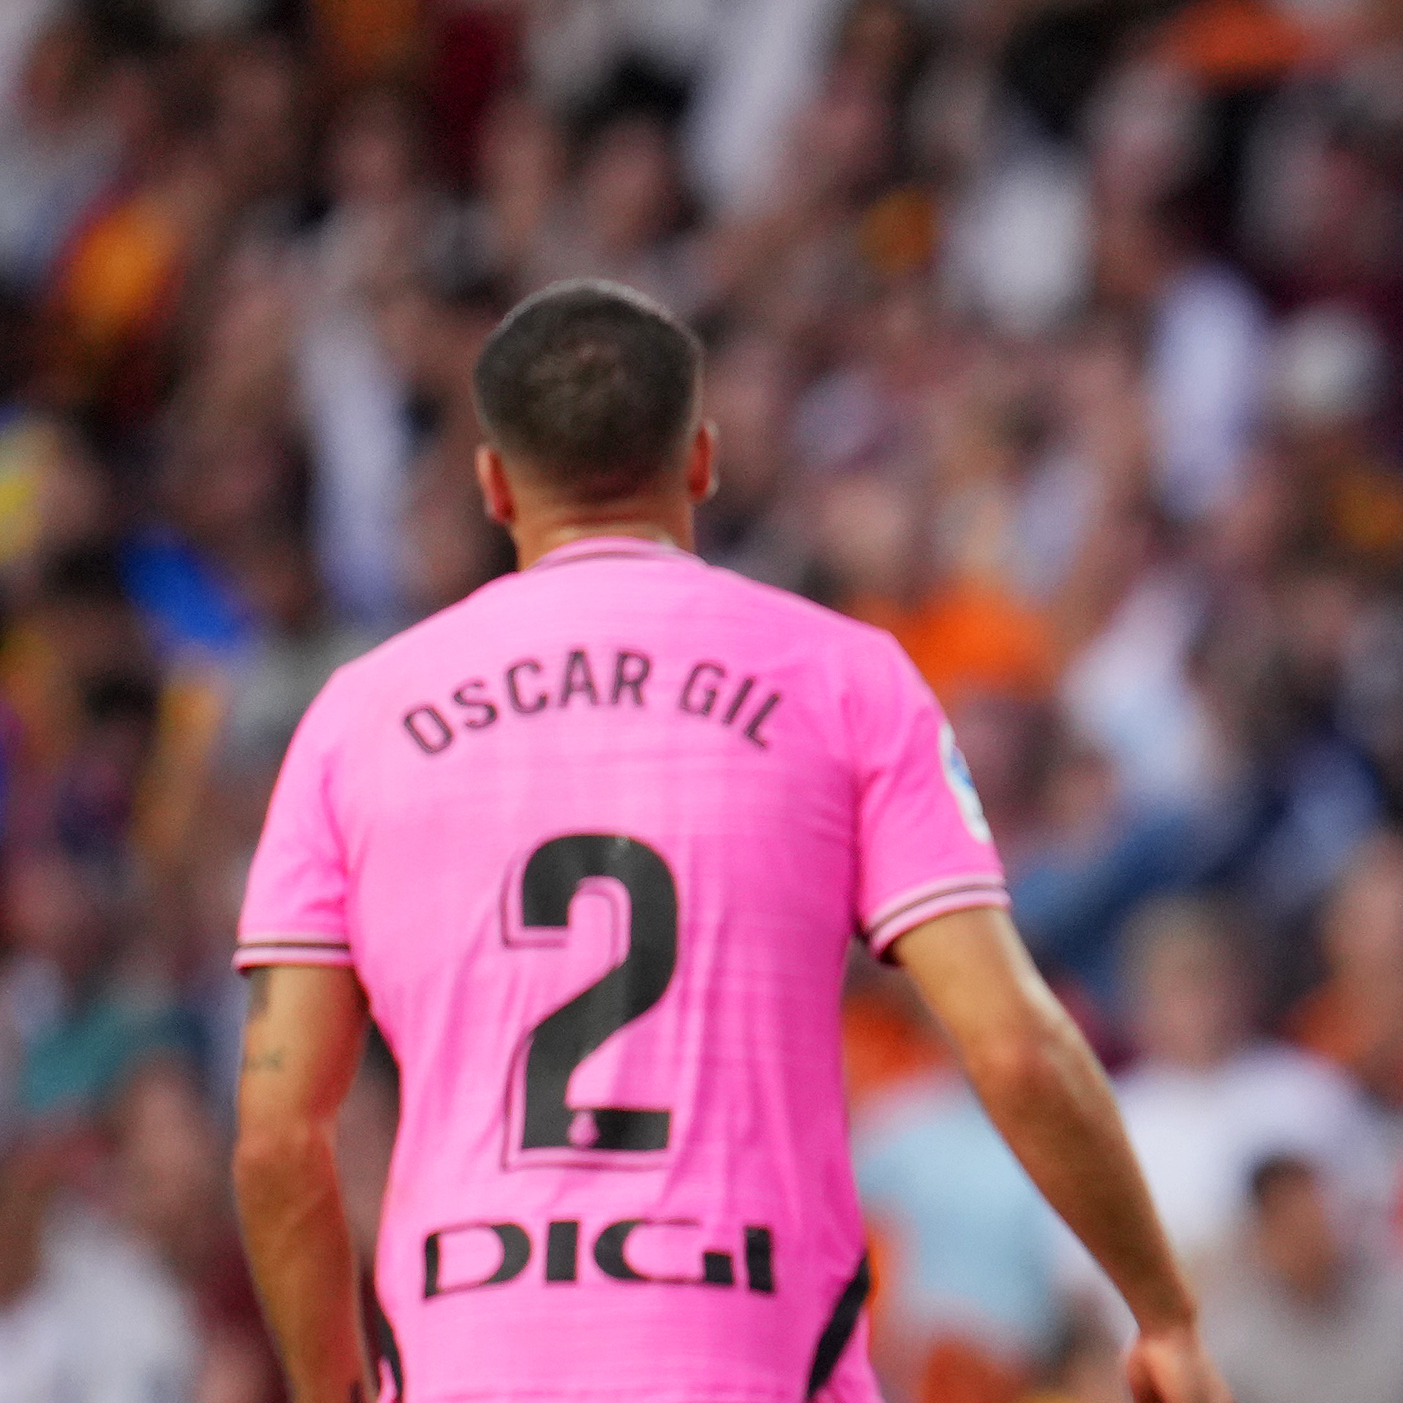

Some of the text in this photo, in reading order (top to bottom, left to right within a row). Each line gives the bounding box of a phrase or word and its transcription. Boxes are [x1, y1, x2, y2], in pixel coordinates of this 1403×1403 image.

[402, 648, 782, 756] OSCAR GIL
[502, 831, 679, 1172] 2
[423, 1218, 776, 1301] DIGI
